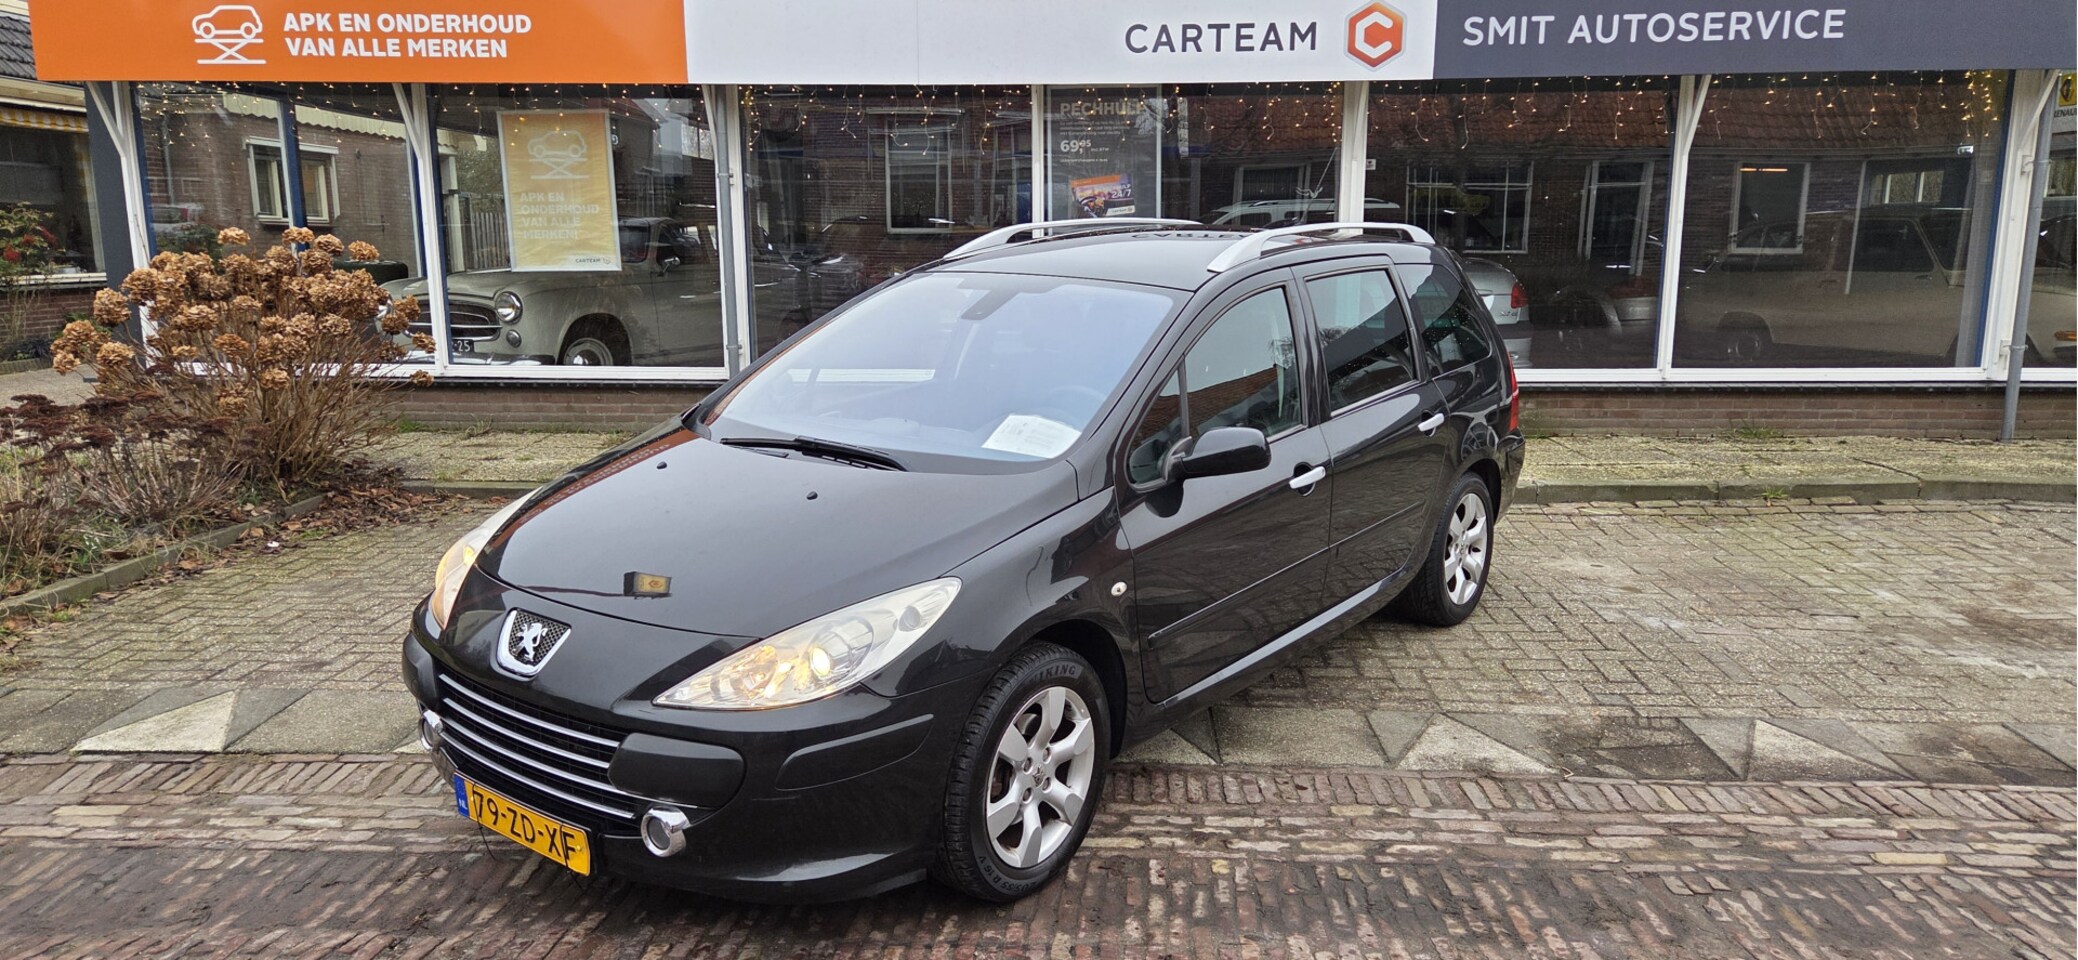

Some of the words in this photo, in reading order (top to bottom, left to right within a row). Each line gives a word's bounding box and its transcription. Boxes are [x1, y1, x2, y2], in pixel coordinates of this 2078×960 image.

[284, 13, 333, 32] APK
[338, 13, 371, 32] EN
[377, 14, 532, 33] ONDERHOUD
[1463, 15, 1555, 46] SMIT
[1567, 9, 1847, 44] AUTOSERVICE
[1125, 22, 1317, 53] CARTEAM
[285, 38, 335, 56] VAN
[341, 38, 401, 57] ALLE
[407, 39, 507, 58] MERKEN
[520, 192, 544, 202] APK
[548, 192, 564, 202] EN
[1111, 189, 1132, 198] 24/7
[520, 204, 600, 215] ONDERHOUD
[521, 217, 547, 227] VAN
[551, 216, 581, 227] ALLE
[451, 340, 471, 352] -25
[473, 790, 576, 860] 79-ZD-XF
